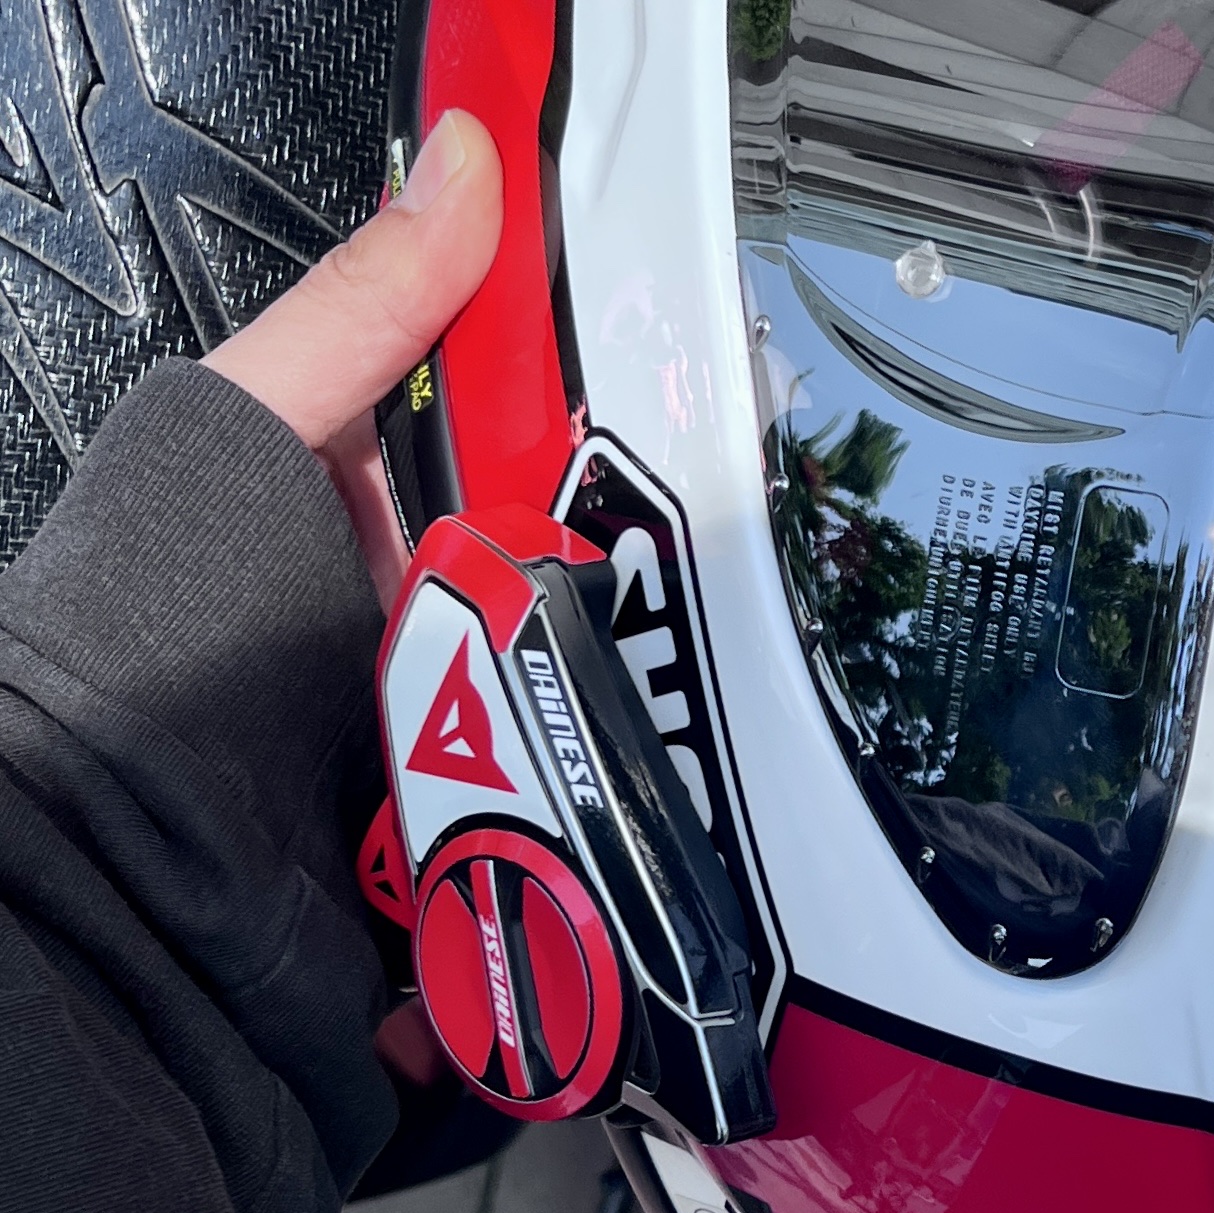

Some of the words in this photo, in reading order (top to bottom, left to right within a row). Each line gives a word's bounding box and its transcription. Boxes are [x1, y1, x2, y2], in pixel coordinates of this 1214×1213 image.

[933, 474, 956, 539] DIURNE
[960, 478, 976, 499] DE
[976, 481, 996, 524] AVEC
[1002, 486, 1024, 530] WITH
[1016, 485, 1045, 562] DAYTIME
[1042, 490, 1064, 534] MIST
[971, 535, 988, 559] LE
[962, 565, 982, 608] FILM
[989, 535, 1014, 613] ANTIFOG
[1026, 544, 1056, 639] RETARDANT
[1004, 616, 1021, 658] ONLY
[519, 649, 604, 808] DAINESE
[479, 914, 516, 1048] DAINESE
